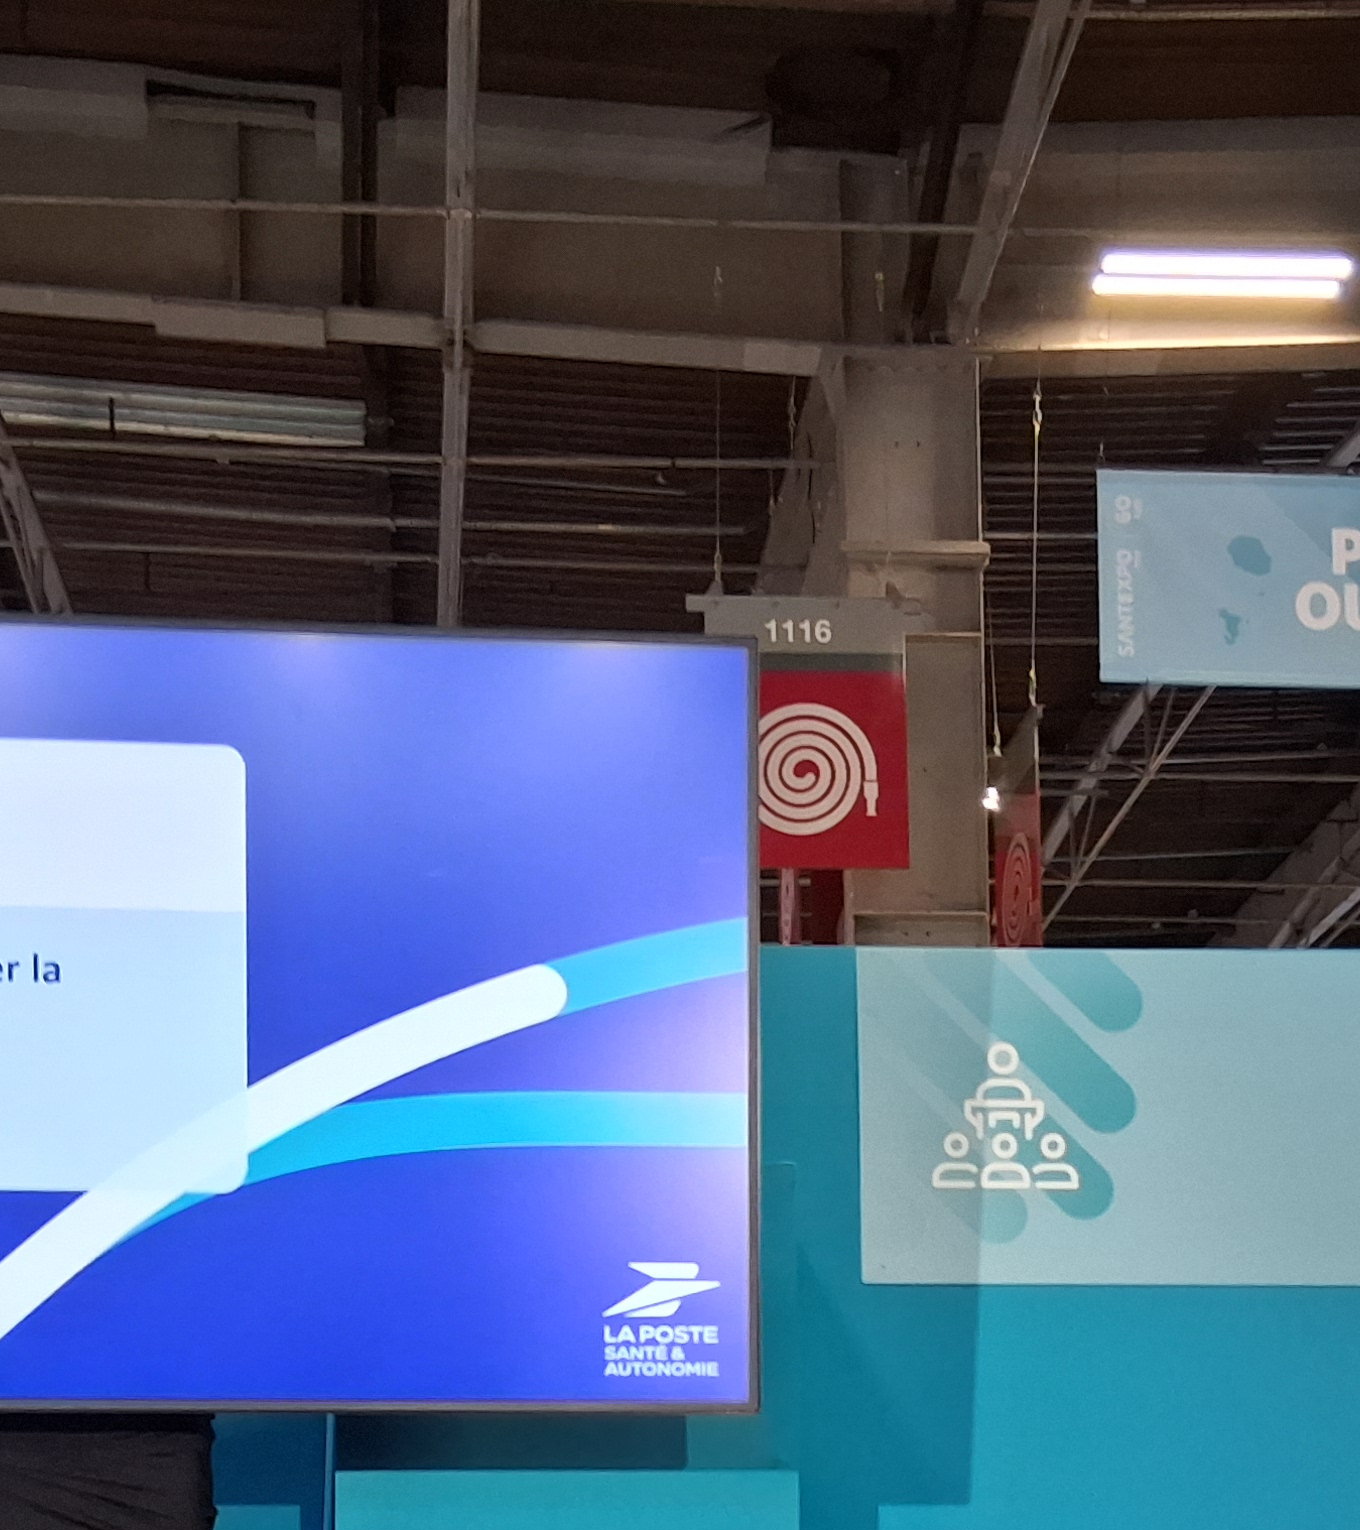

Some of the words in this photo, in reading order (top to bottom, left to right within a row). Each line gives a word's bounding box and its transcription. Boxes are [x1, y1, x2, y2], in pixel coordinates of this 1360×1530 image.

[764, 619, 832, 644] 1116
[33, 952, 61, 984] la
[603, 1324, 637, 1345] LA
[639, 1324, 720, 1345] POSTE
[604, 1344, 668, 1361] SANTÉ
[670, 1345, 686, 1361] &
[603, 1361, 720, 1377] AUTONOMIE
